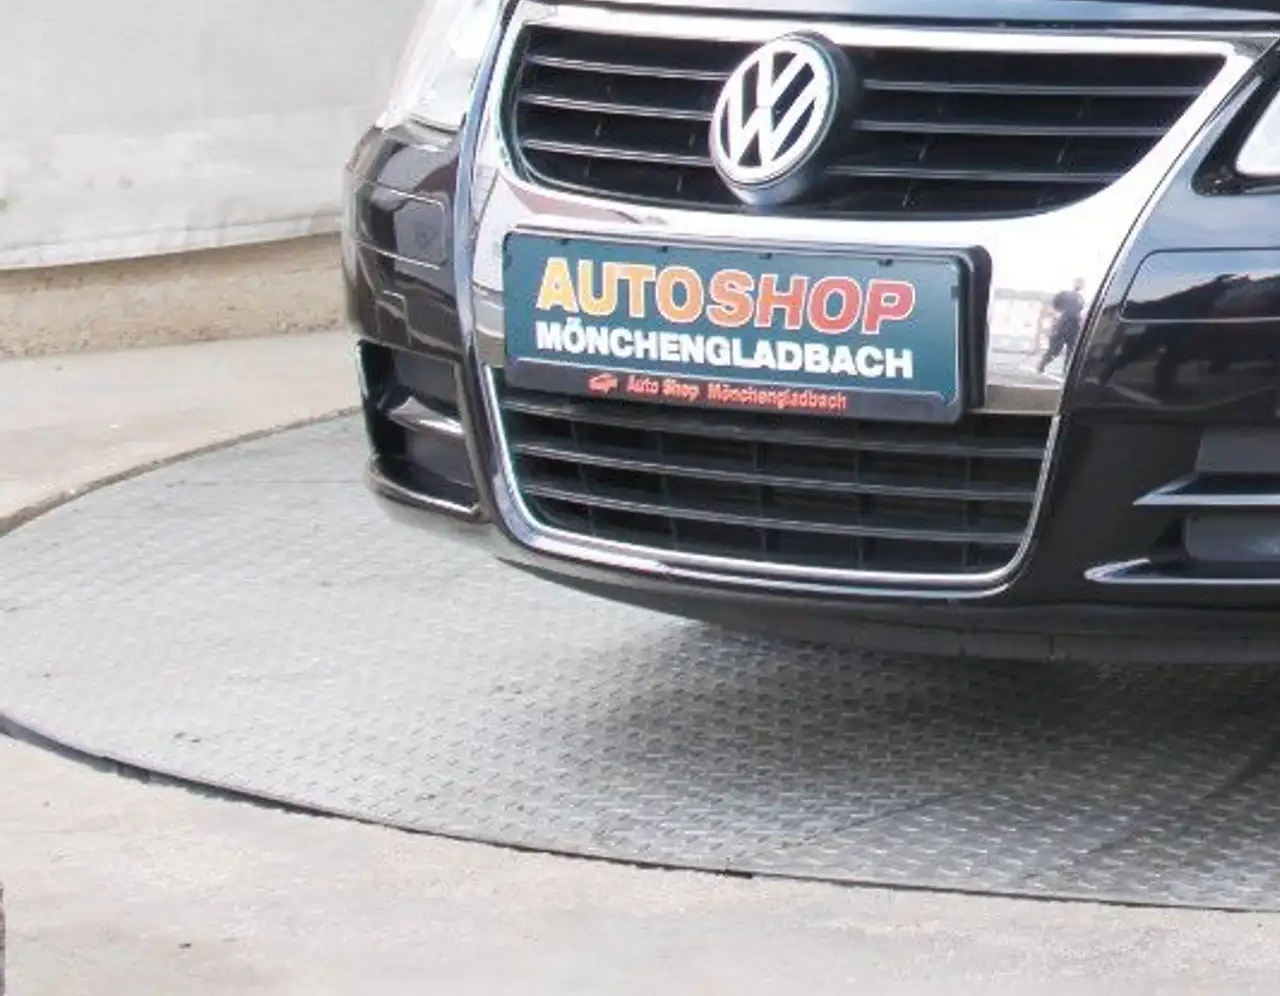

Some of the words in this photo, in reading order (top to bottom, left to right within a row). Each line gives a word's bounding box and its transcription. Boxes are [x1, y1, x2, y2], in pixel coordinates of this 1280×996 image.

[535, 256, 916, 335] AUTOSHOP
[534, 317, 914, 380] MÖNCHENGLADBACH
[626, 374, 659, 394] Auto
[662, 378, 700, 402] Shop
